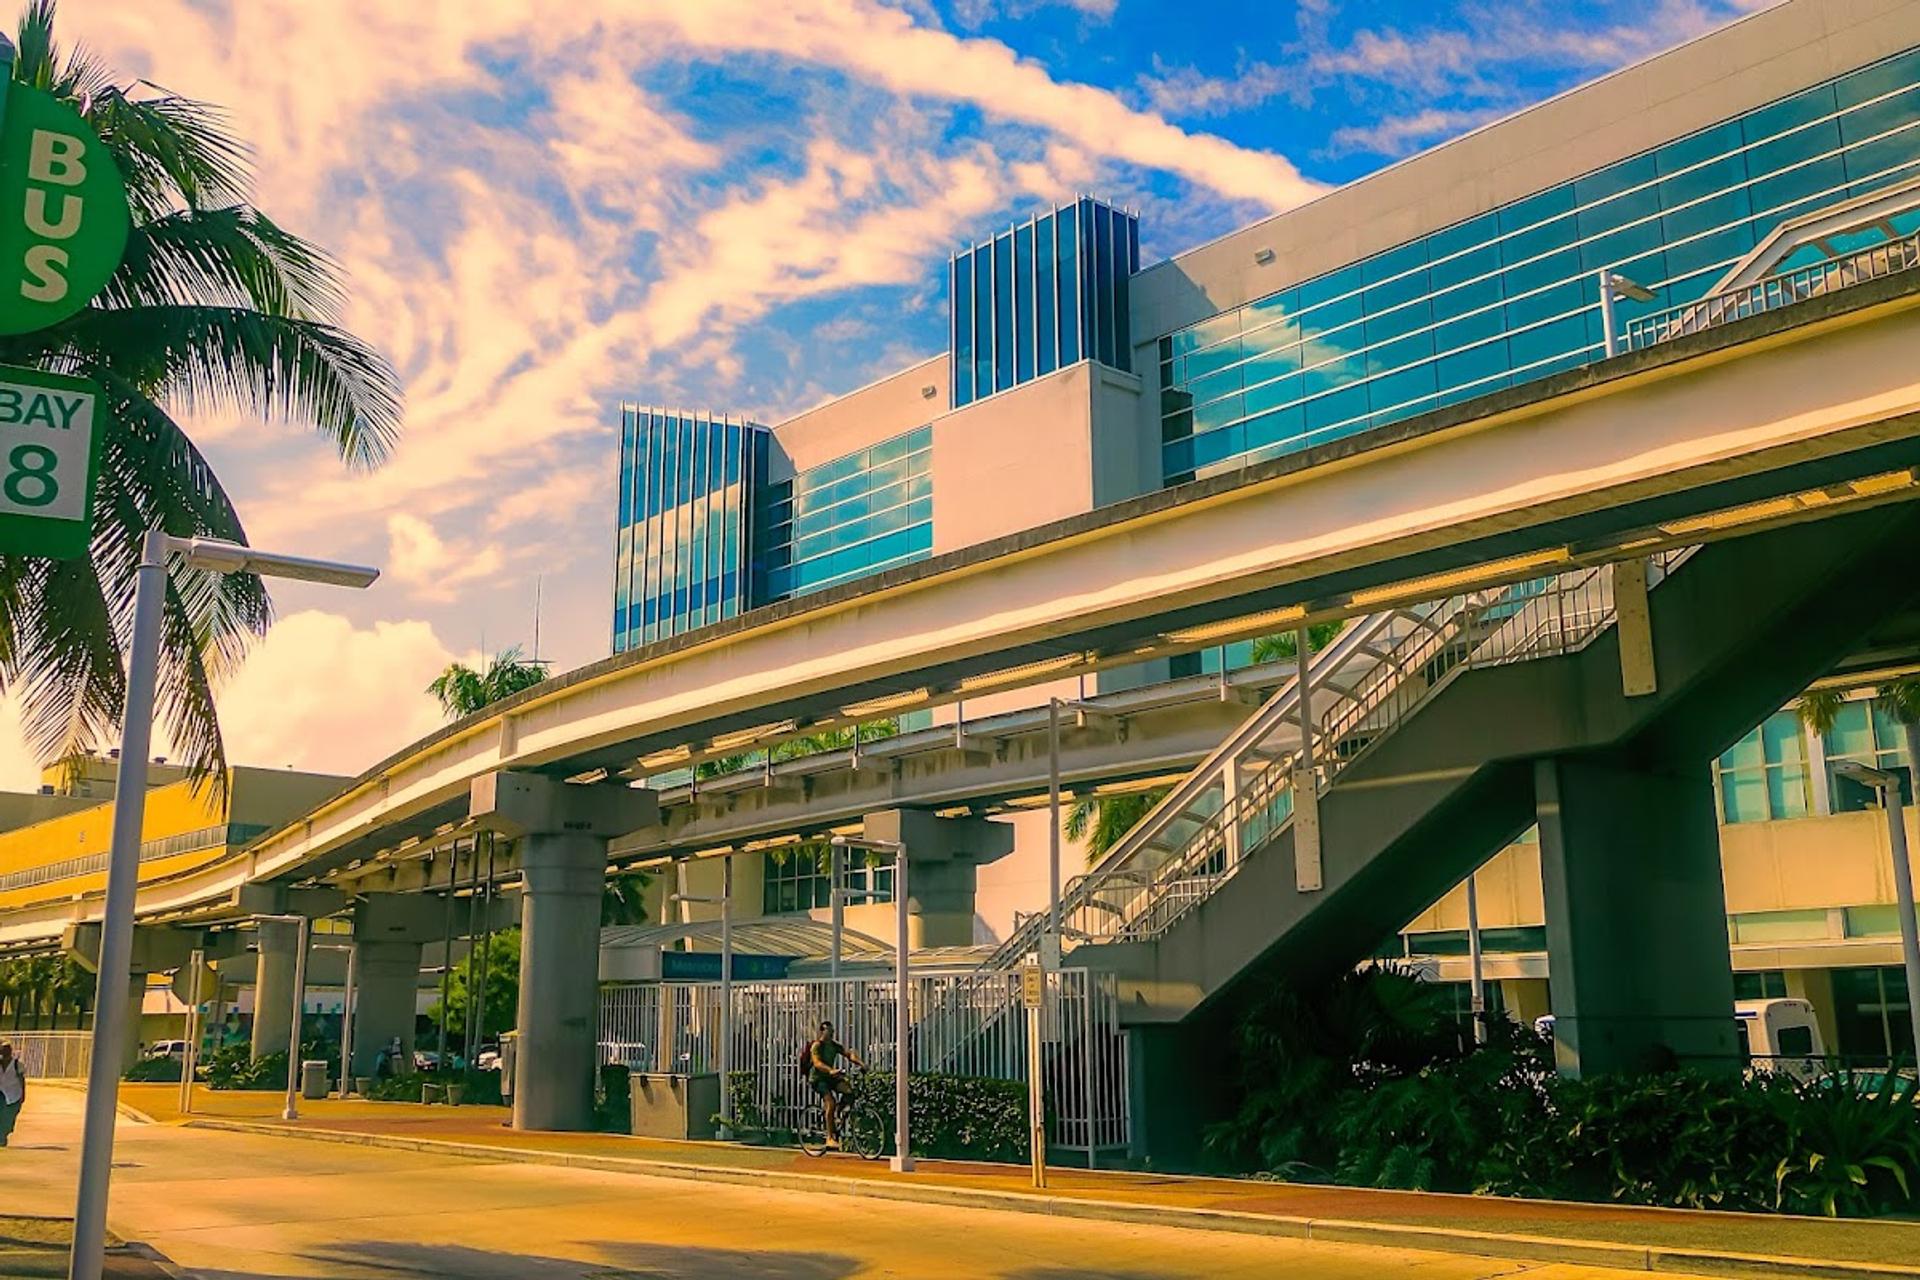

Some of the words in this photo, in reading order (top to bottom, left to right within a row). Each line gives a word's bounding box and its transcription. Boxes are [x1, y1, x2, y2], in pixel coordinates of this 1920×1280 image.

[20, 128, 87, 302] BUS
[0, 389, 84, 429] BAY
[4, 444, 58, 507] 8
